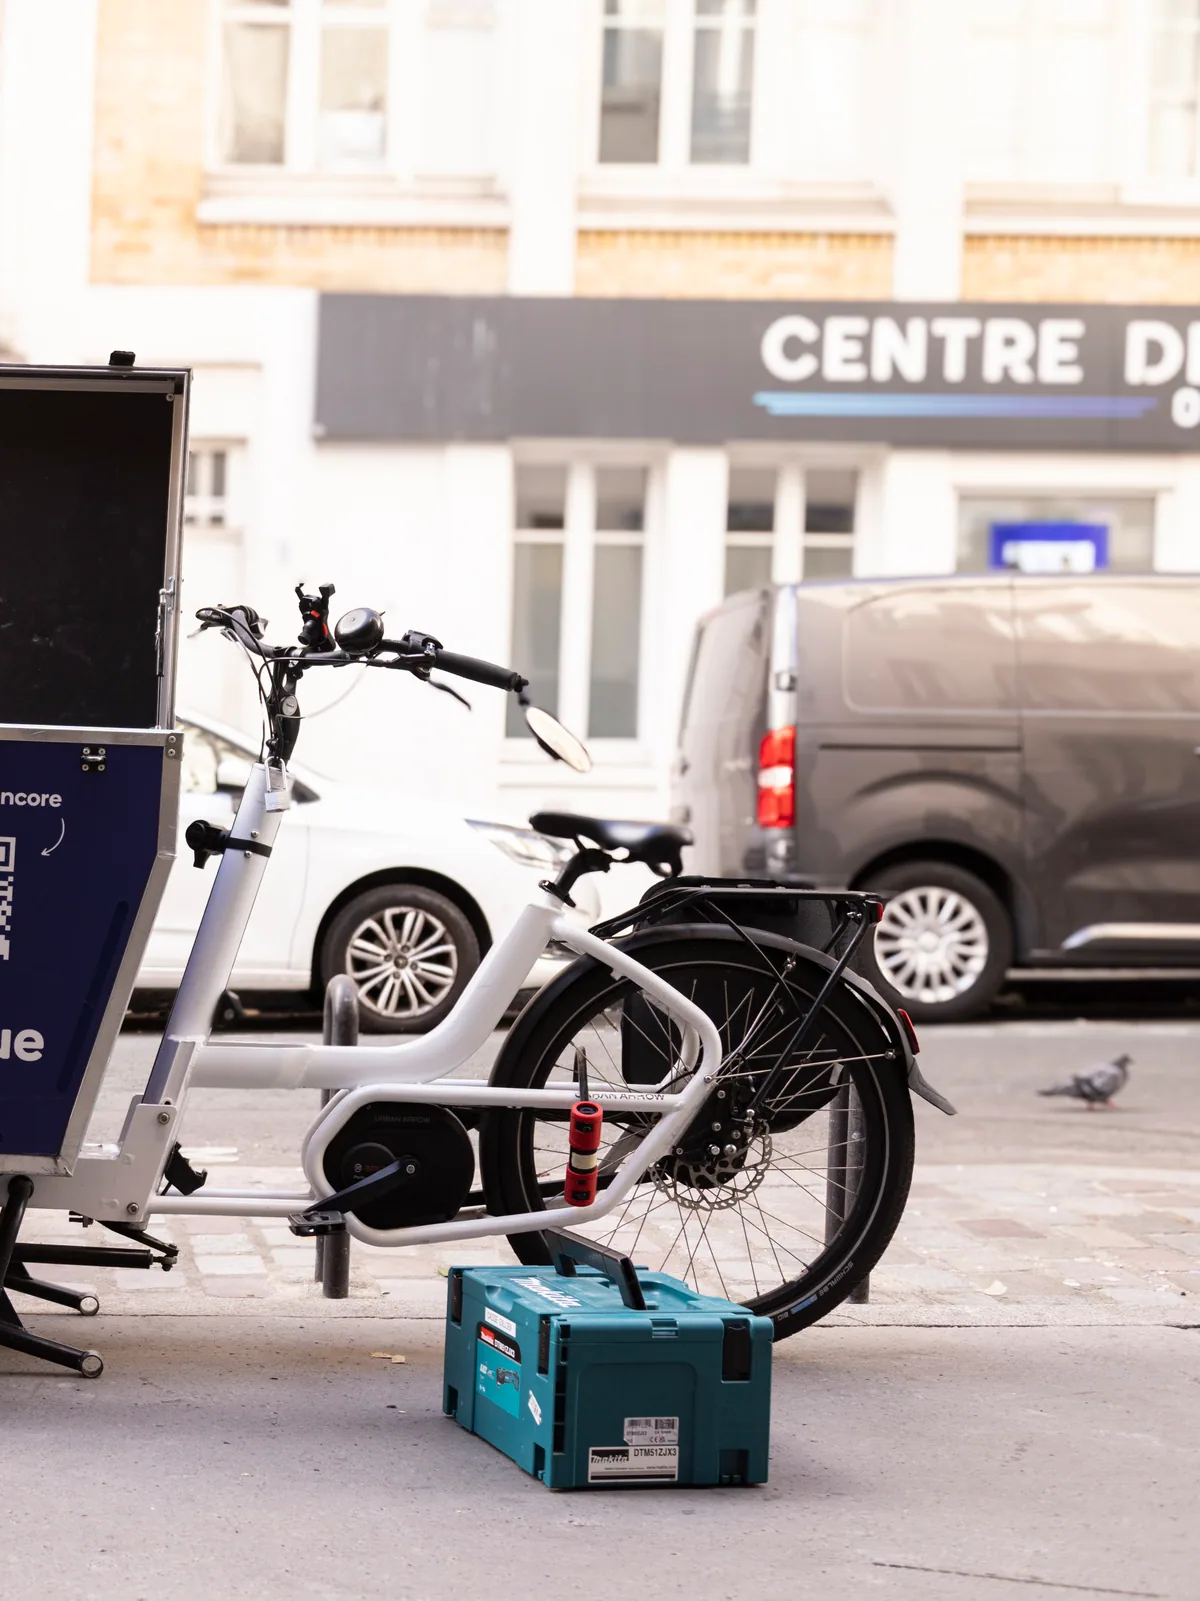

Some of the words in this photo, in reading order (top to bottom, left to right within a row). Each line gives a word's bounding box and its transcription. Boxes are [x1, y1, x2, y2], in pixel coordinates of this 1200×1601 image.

[760, 314, 1086, 385] CENTRE
[818, 1260, 855, 1297] SCHWALBE
[633, 1448, 677, 1457] DTM51ZJX3
